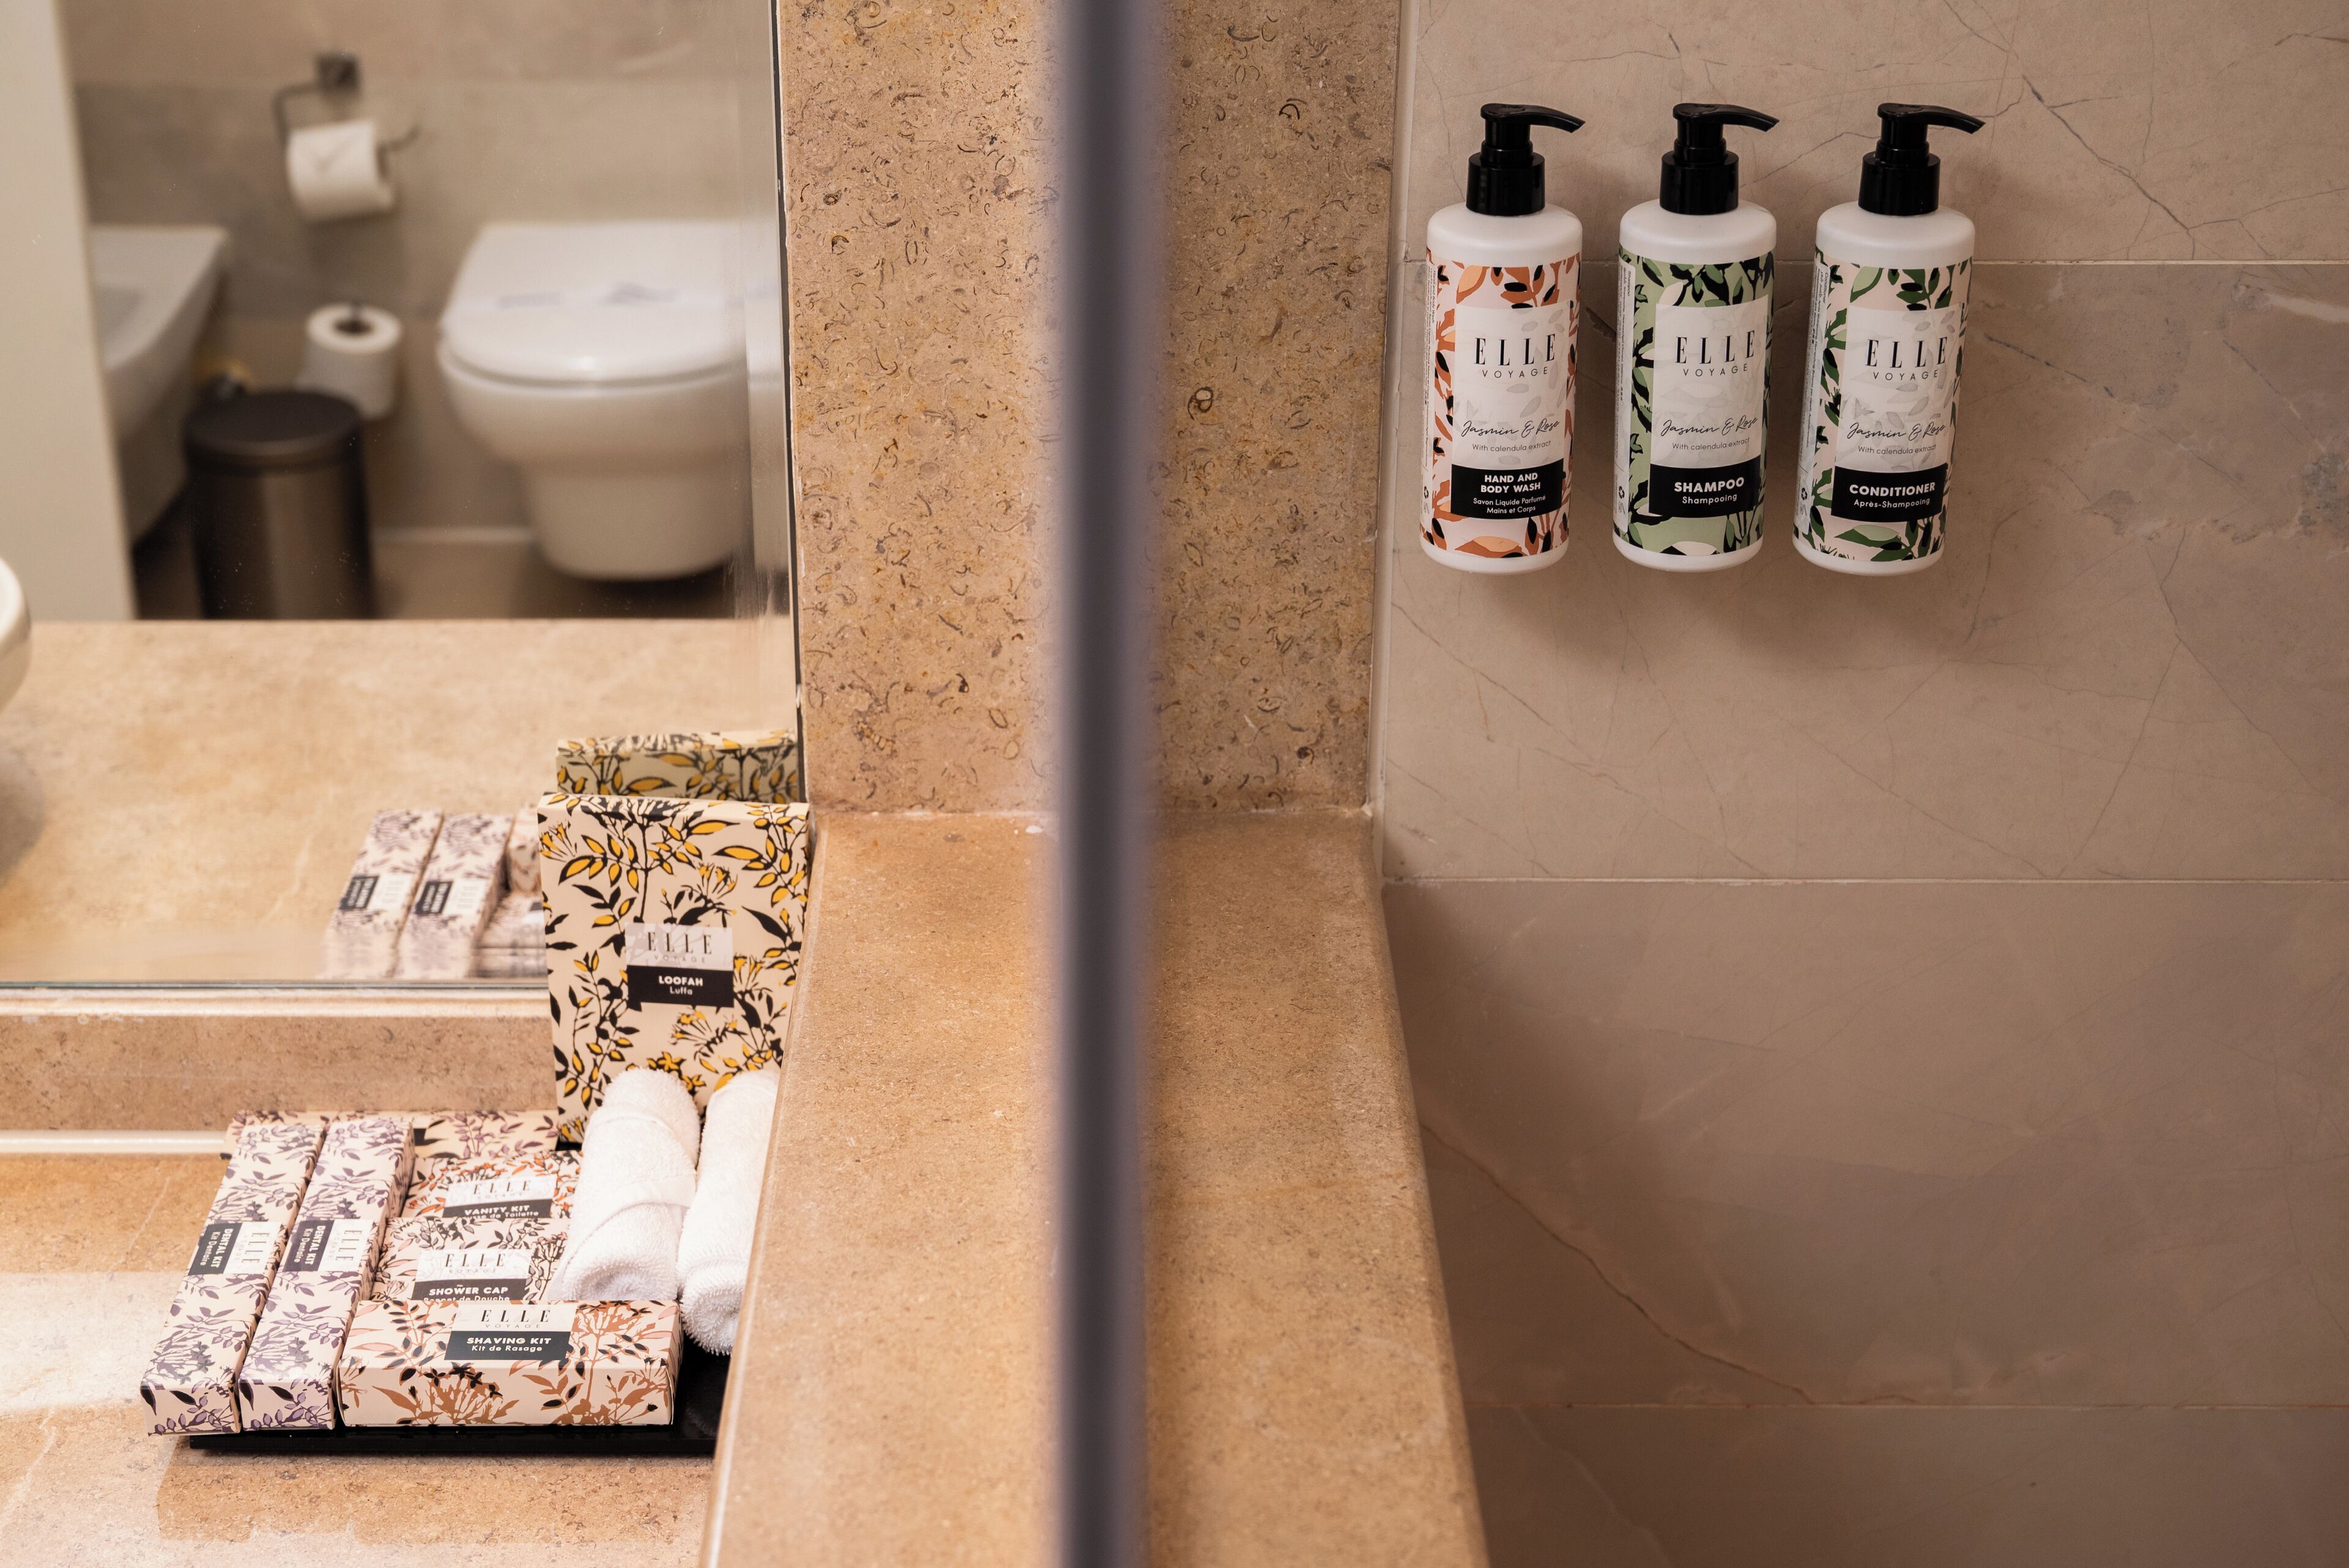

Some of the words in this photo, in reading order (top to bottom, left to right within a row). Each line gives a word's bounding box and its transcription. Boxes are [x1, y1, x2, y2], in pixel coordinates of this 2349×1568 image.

[1474, 333, 1556, 366] ELLE
[1675, 330, 1754, 365] ELLE
[1865, 336, 1947, 368] ELLE
[1482, 366, 1548, 378] VOYAGE
[1683, 363, 1748, 377] VOYAGE
[1873, 370, 1939, 381] VOYAGE
[1461, 420, 1519, 437] Jasmin
[1521, 420, 1534, 438] &
[1536, 418, 1560, 435] Rose
[1661, 419, 1720, 436] Jasmin
[1721, 417, 1734, 436] &
[1735, 415, 1758, 432] Rose
[1847, 422, 1906, 439] Jasmin
[1908, 423, 1922, 441] &
[1922, 422, 1946, 438] Rose
[1528, 440, 1551, 450] extract
[1728, 437, 1750, 447] extract
[1858, 445, 1874, 454] With
[1915, 444, 1937, 453] extract
[1517, 472, 1538, 482] AND
[1480, 485, 1509, 493] BODY
[1513, 482, 1541, 492] WASH
[1674, 477, 1745, 492] SHAMPOO
[1849, 481, 1935, 497] CONDITIONER
[1495, 499, 1520, 507] Liquide
[1521, 494, 1546, 504] Parfumé
[1682, 494, 1737, 505] Shampooing
[1854, 498, 1931, 508] Après-Shampooing
[648, 932, 712, 954] ELLE
[658, 975, 703, 986] LOOFAH
[670, 986, 693, 995] Luffa
[473, 1180, 531, 1194] ELLE
[464, 1206, 507, 1216] VANITY
[210, 1231, 221, 1241] Kit
[303, 1228, 313, 1237] Kit
[309, 1225, 326, 1252] DENTAL
[215, 1228, 234, 1255] DENTAL
[242, 1232, 270, 1263] ELLE
[336, 1230, 363, 1261] ELLE
[199, 1241, 217, 1266] Dentaire
[294, 1237, 310, 1263] Dentaire
[210, 1255, 224, 1268] KIT
[305, 1253, 317, 1265] KIT
[445, 1254, 506, 1268] ELLE
[429, 1287, 479, 1296] SHOWER
[481, 1309, 551, 1323] ELLE
[505, 1345, 543, 1353] Rasage
